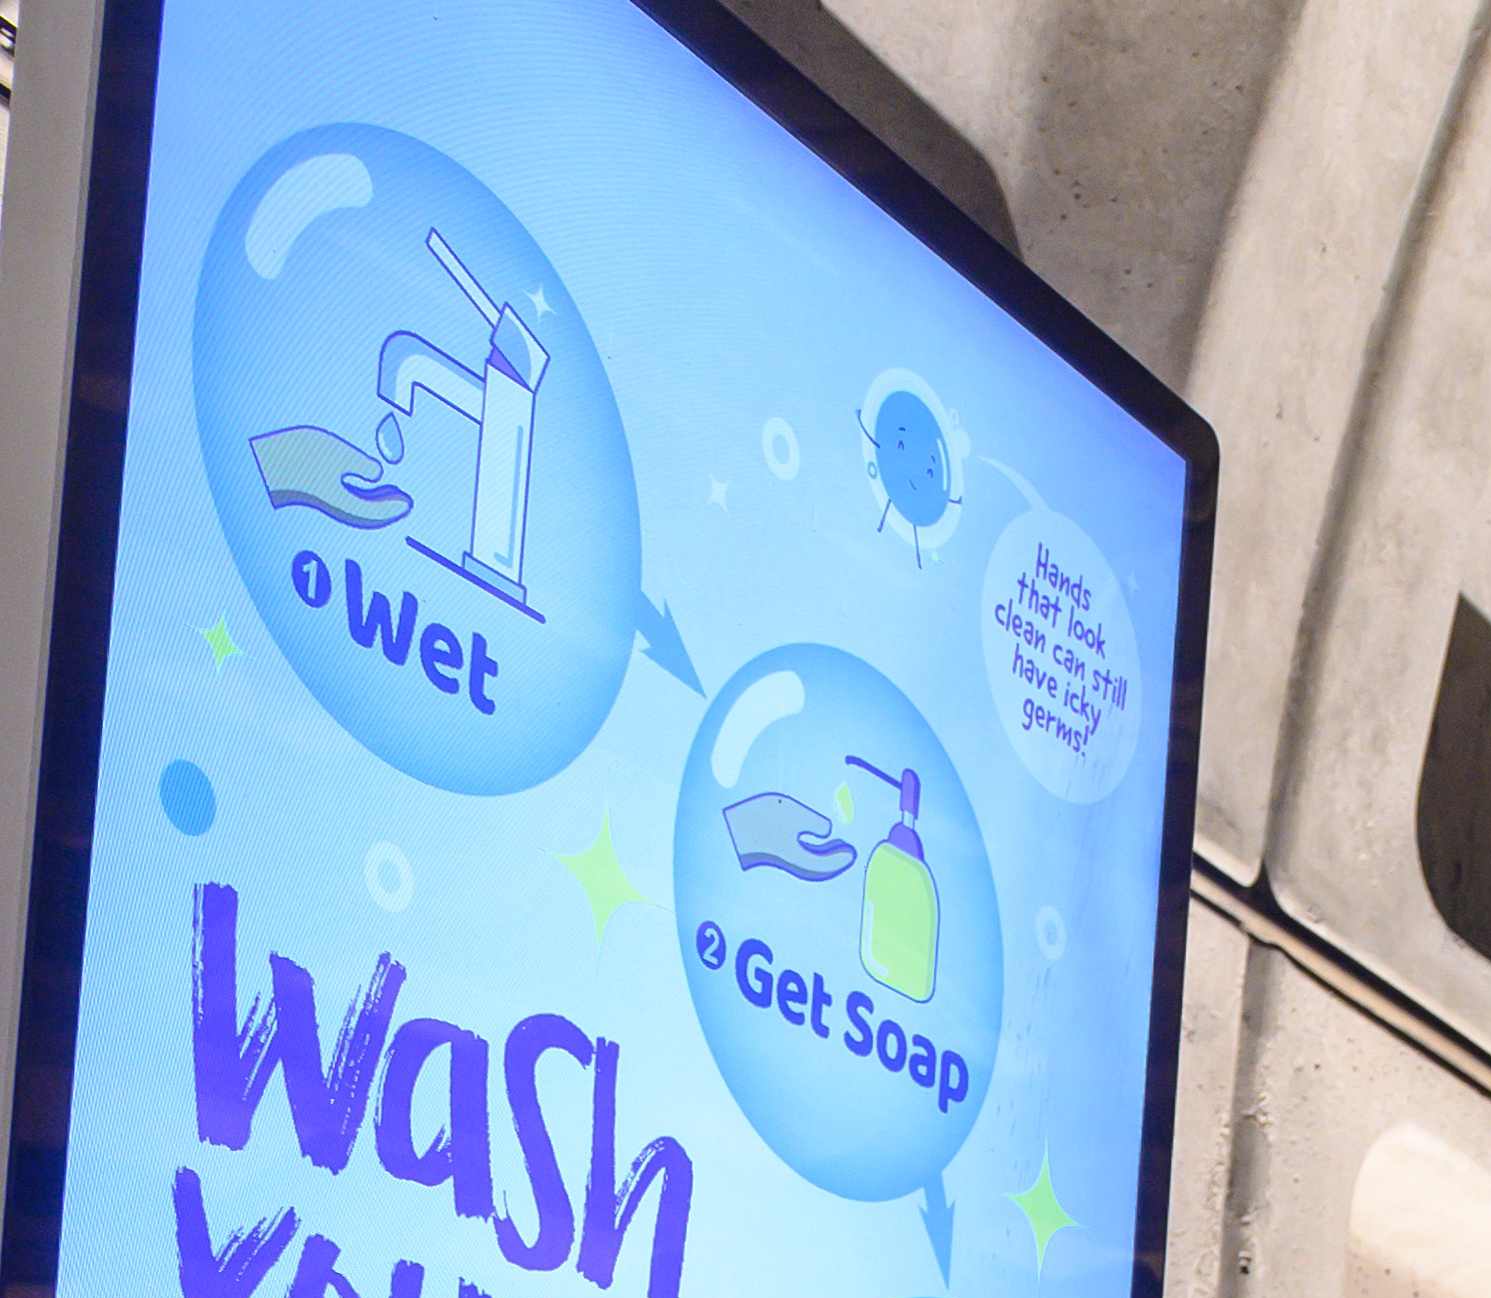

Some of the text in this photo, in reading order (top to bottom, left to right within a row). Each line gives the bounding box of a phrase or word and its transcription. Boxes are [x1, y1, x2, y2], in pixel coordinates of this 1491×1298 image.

[1017, 572, 1106, 659] that look
[1036, 542, 1092, 611] Hands
[345, 559, 498, 715] Wet
[995, 598, 1128, 710] clean can still
[1012, 643, 1101, 736] have icky
[1022, 698, 1090, 757] germs!
[735, 938, 832, 1039] Get
[844, 991, 969, 1114] Soap
